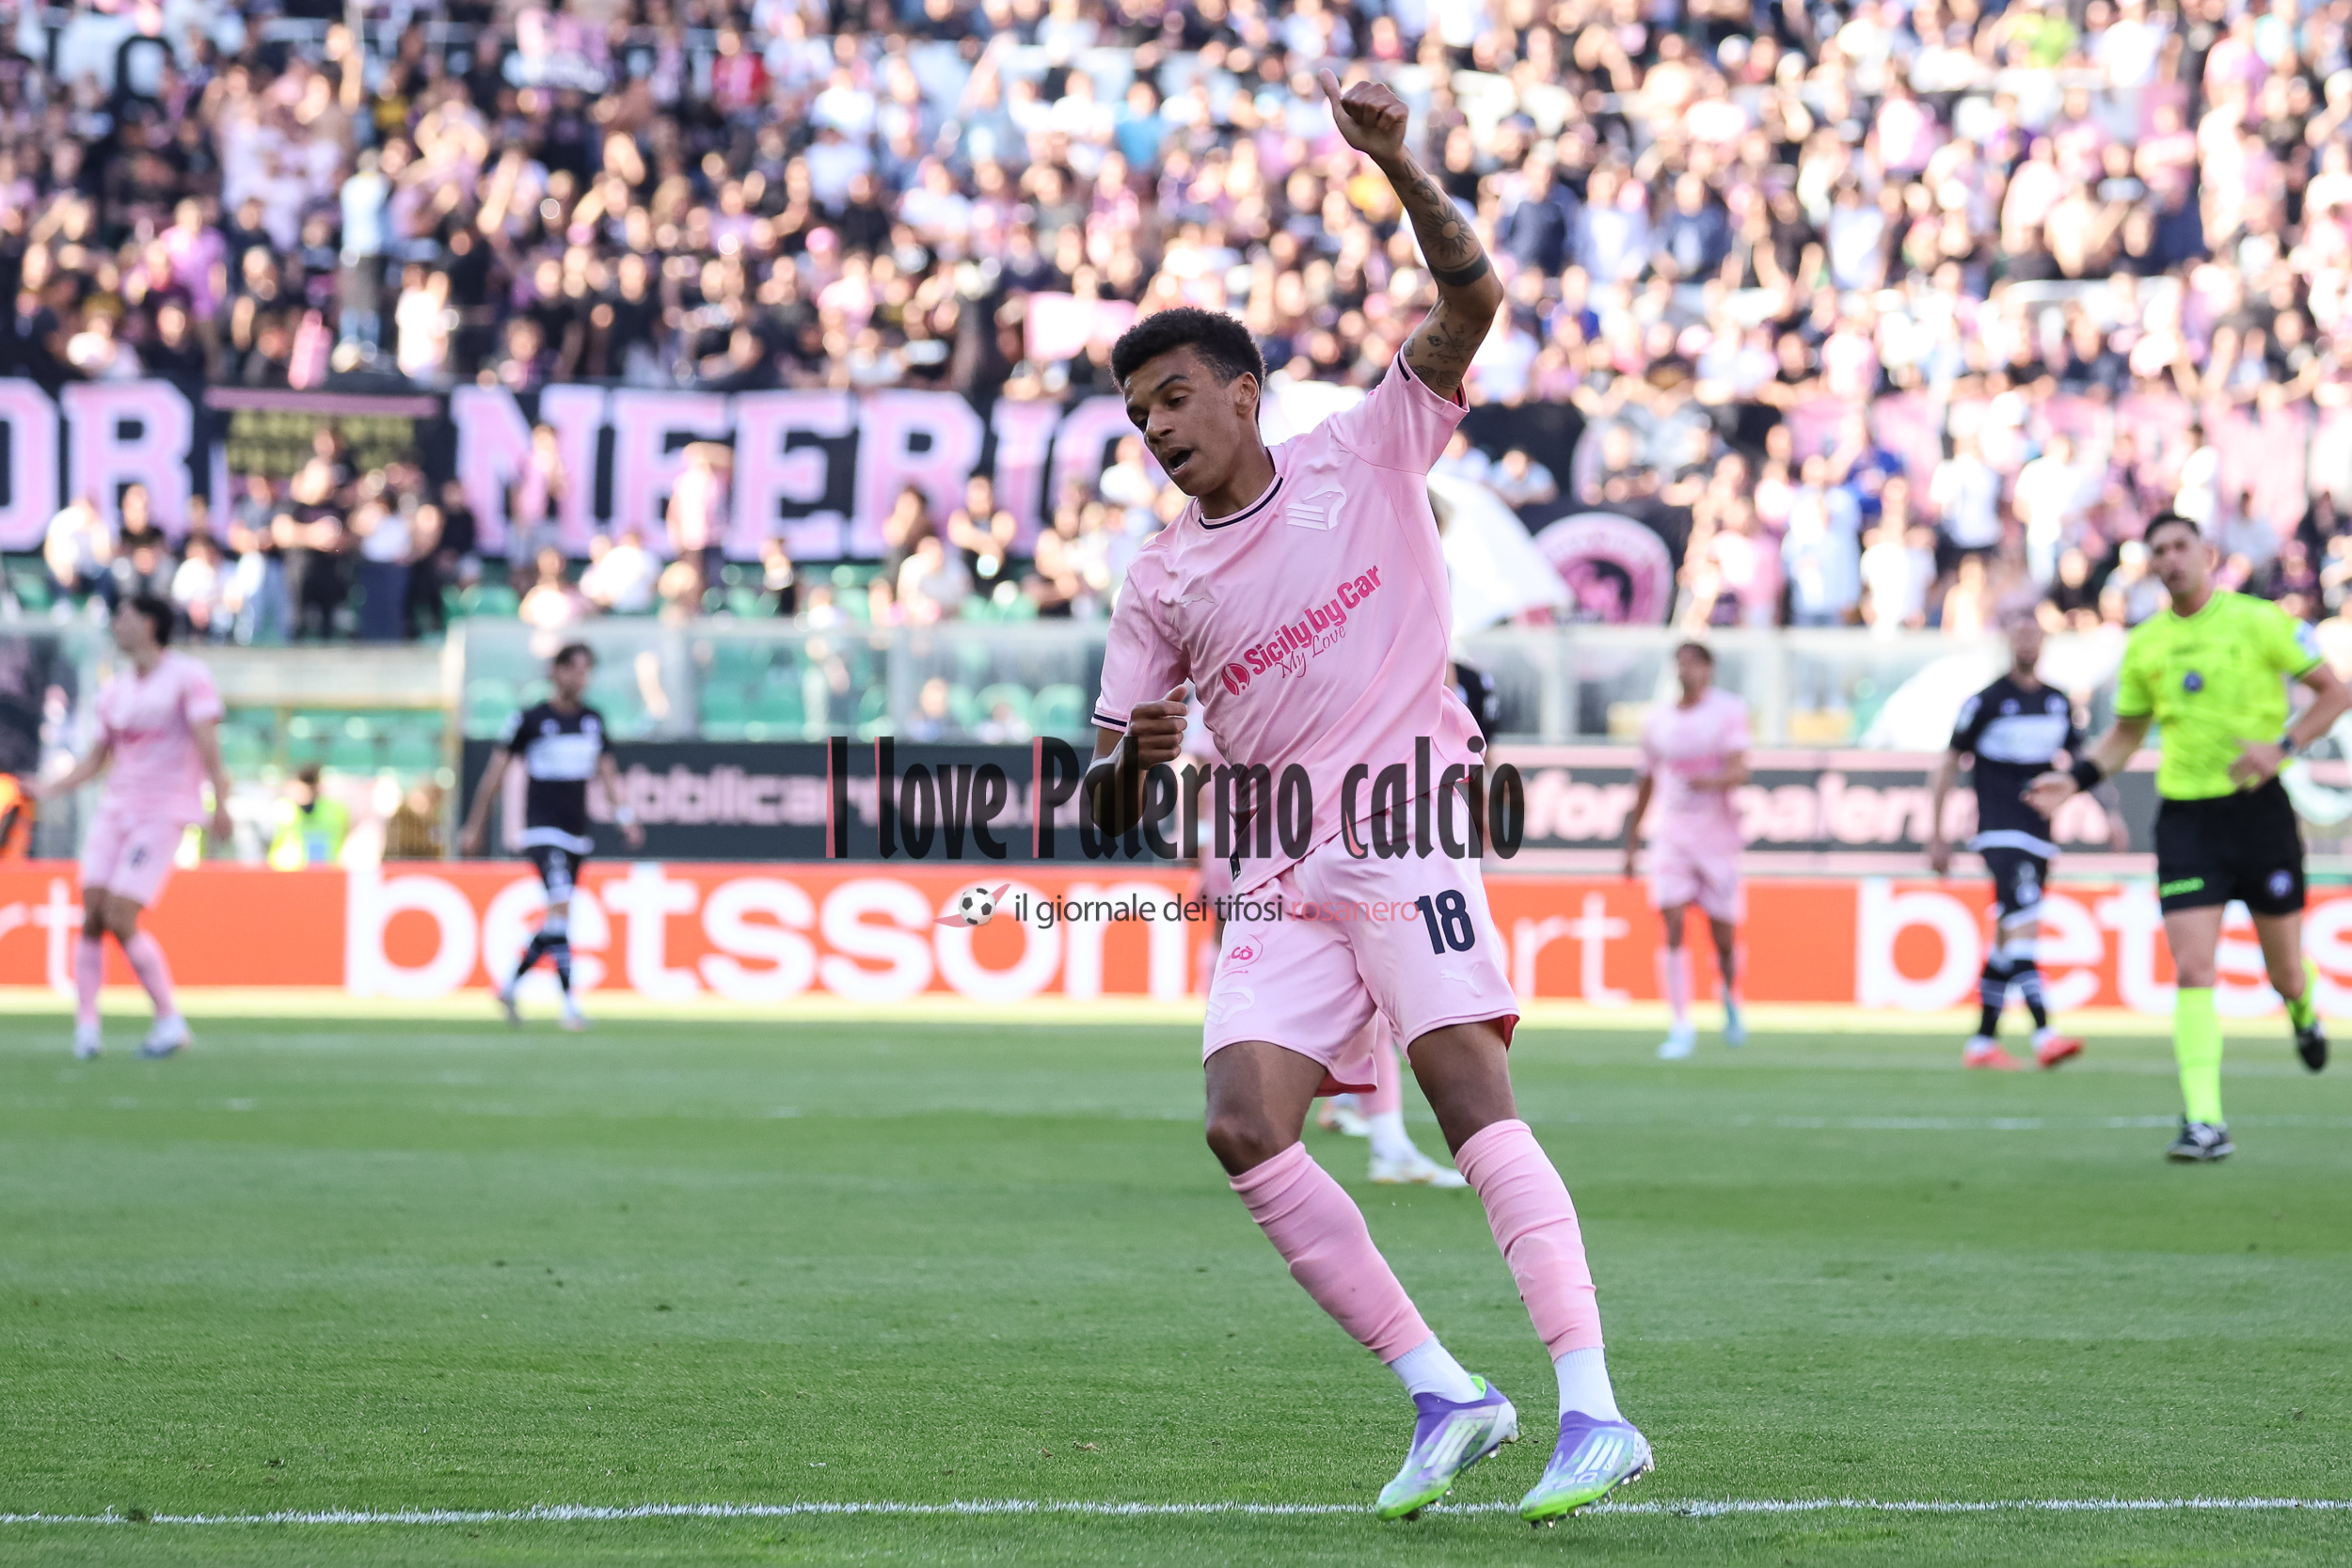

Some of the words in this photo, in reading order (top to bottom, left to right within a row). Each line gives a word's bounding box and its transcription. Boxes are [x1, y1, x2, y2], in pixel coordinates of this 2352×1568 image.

[1243, 620, 1313, 675] Sicily
[1304, 598, 1347, 634] by
[1336, 564, 1382, 610] Car
[1275, 650, 1307, 678] My
[1311, 625, 1346, 658] Love
[344, 860, 1189, 1001] betsson
[1413, 889, 1476, 955] 18
